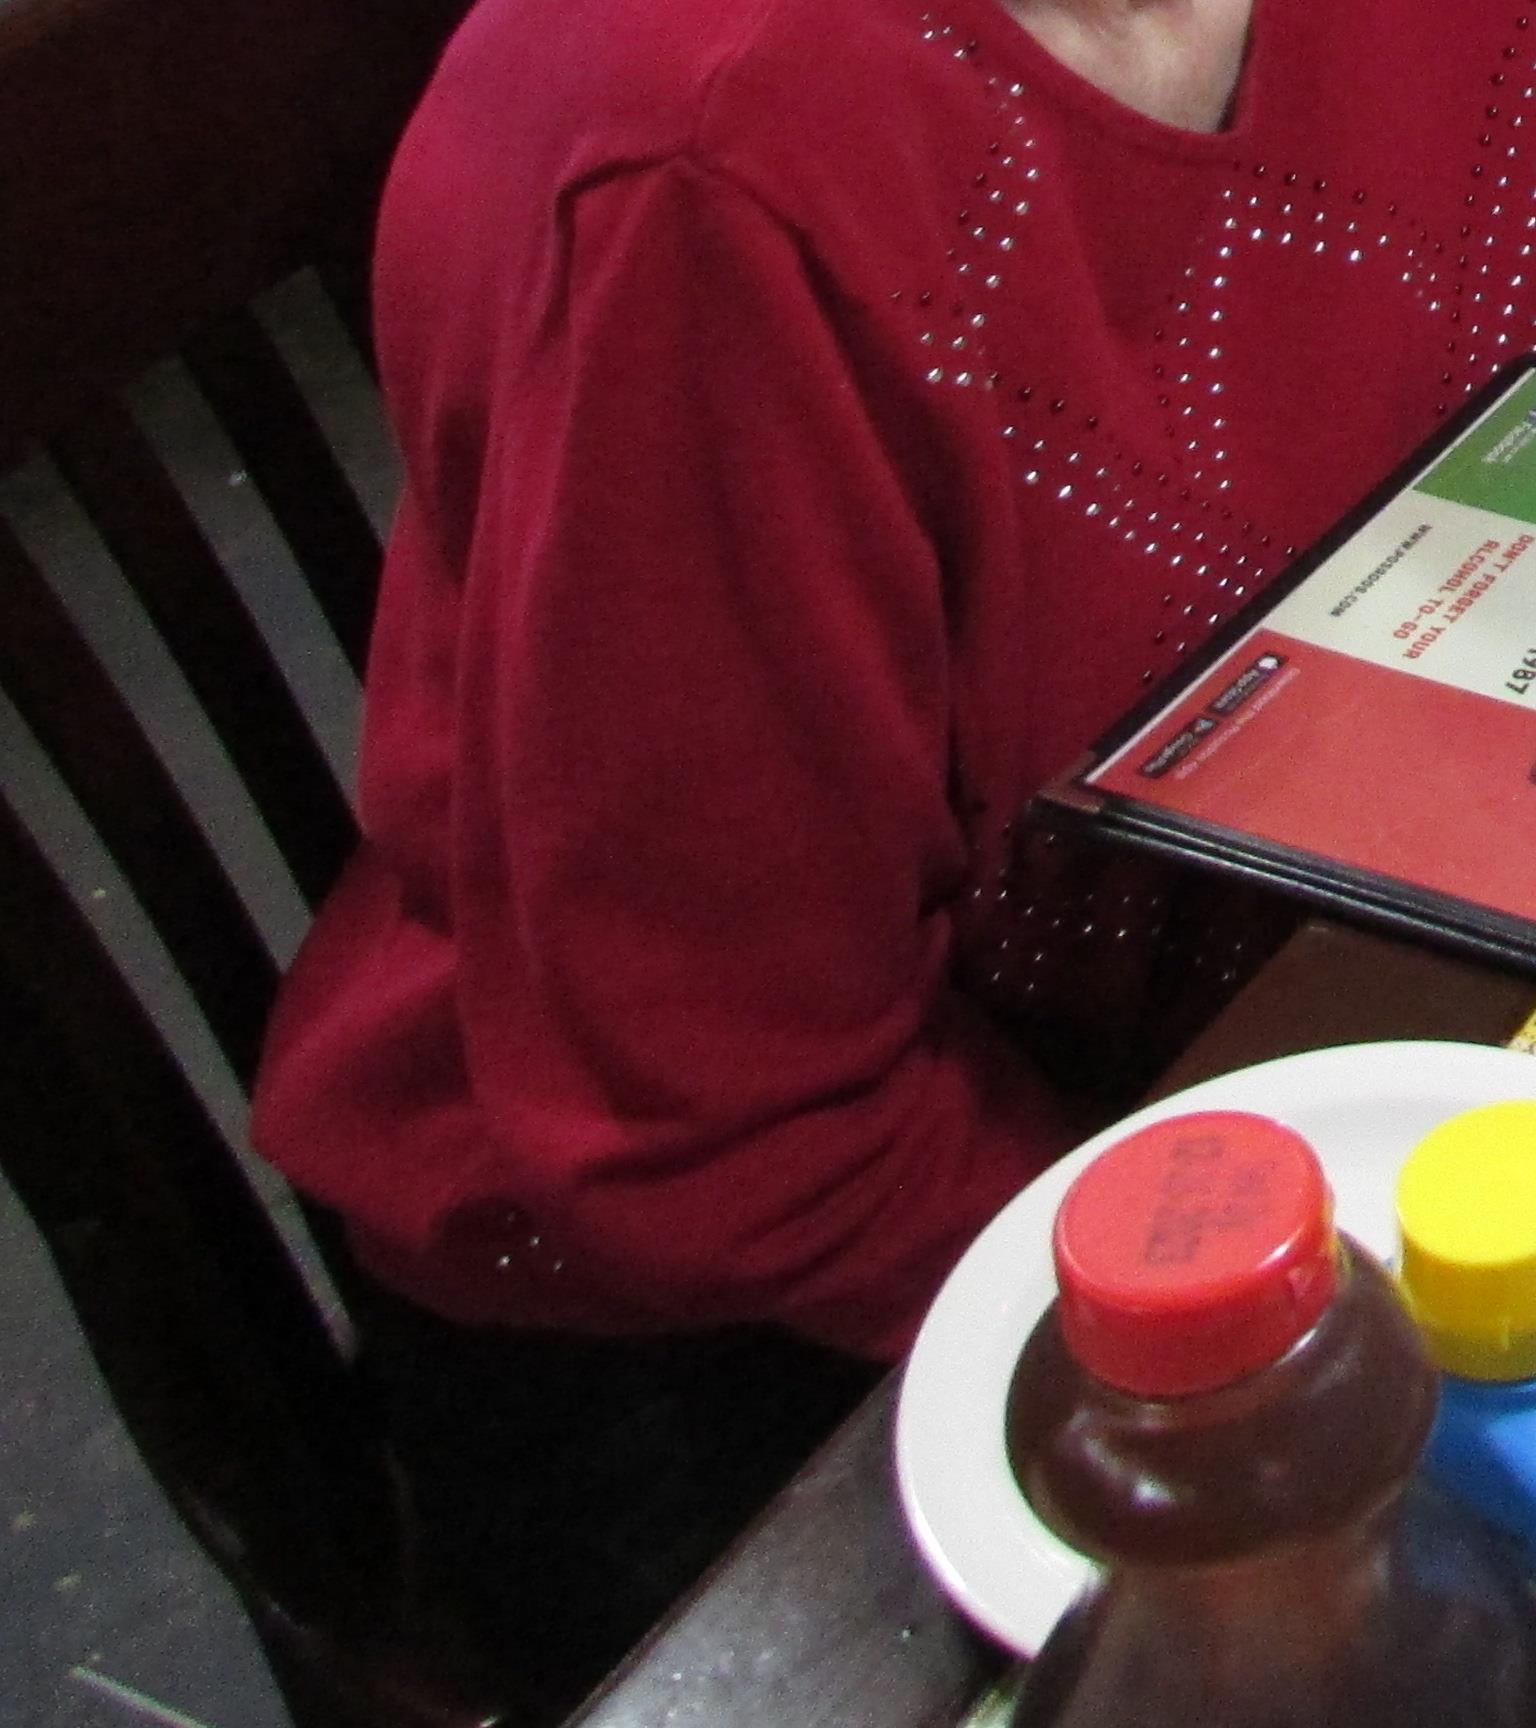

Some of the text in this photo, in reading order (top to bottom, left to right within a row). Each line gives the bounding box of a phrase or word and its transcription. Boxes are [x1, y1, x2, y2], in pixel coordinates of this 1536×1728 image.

[1393, 598, 1443, 640] TO-GO
[1403, 534, 1536, 660] DON'T FORGET YOUR
